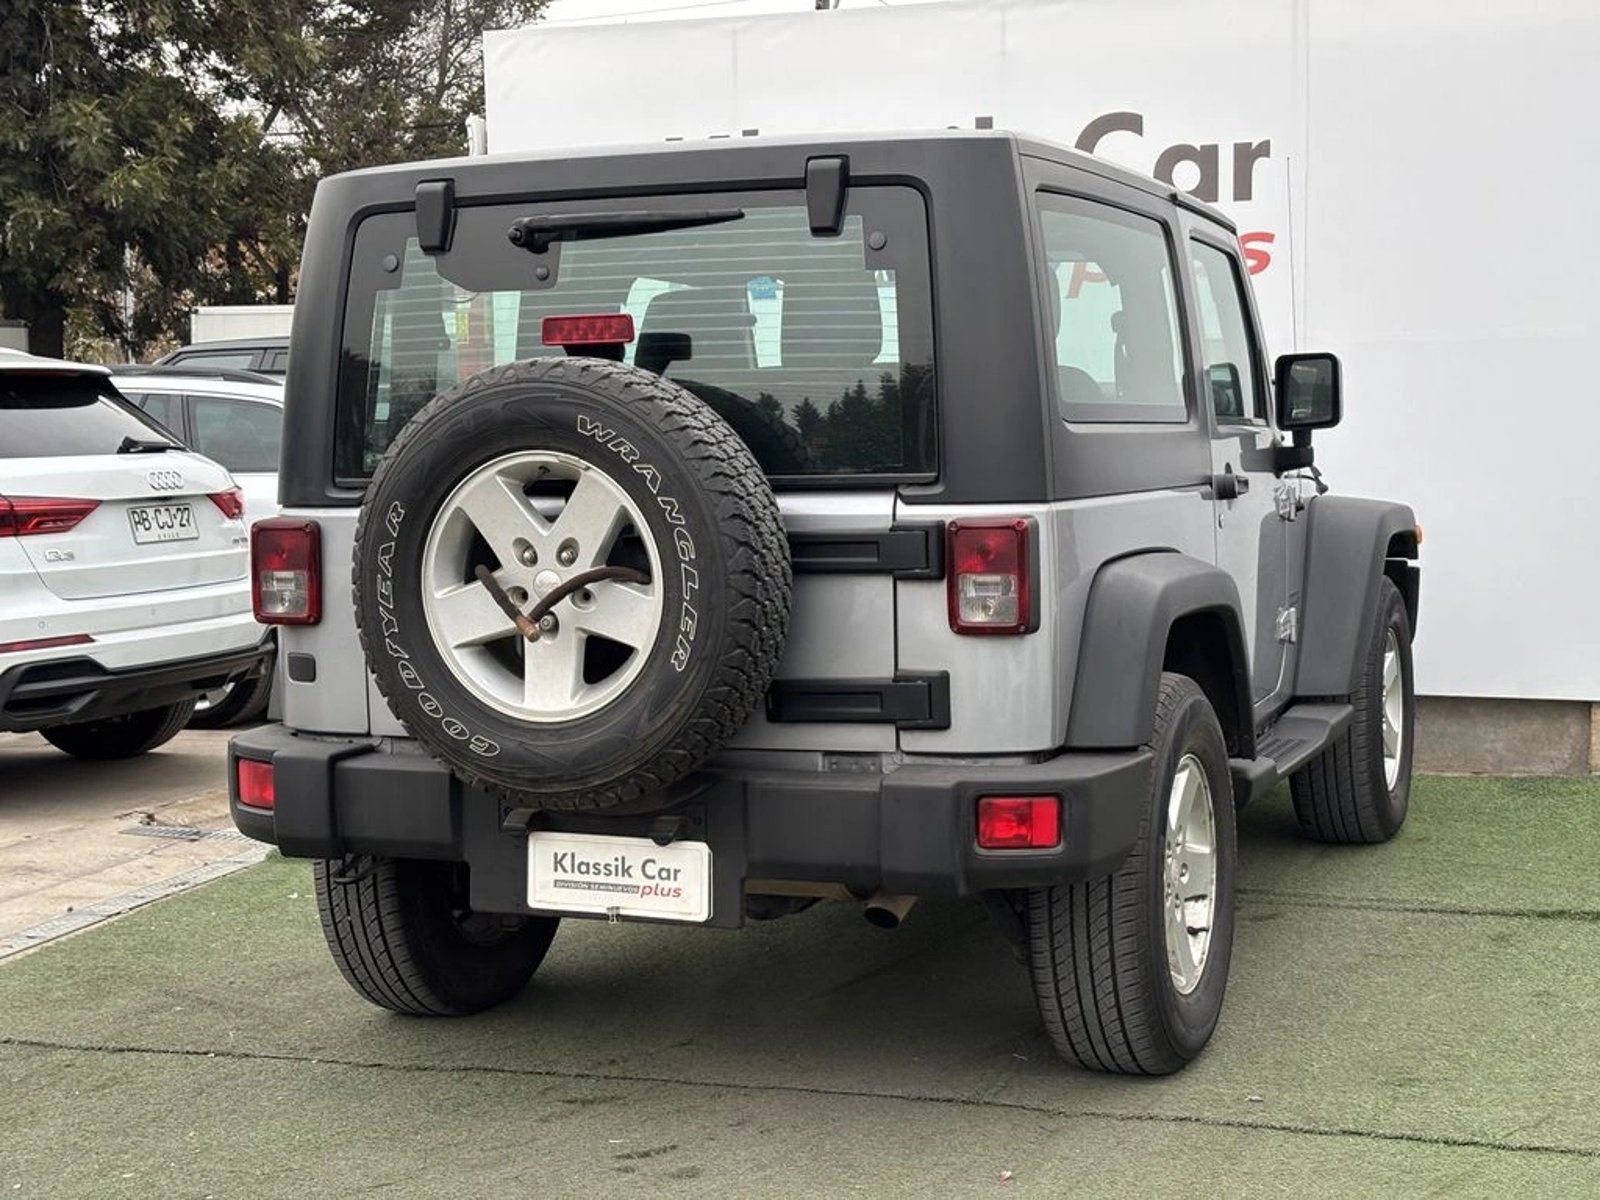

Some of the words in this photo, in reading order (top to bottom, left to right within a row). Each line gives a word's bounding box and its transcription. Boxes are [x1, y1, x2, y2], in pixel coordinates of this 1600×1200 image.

[578, 415, 698, 673] WRANGLER
[377, 501, 500, 757] GOODYEAR
[553, 852, 633, 878] Klassik
[641, 858, 681, 882] Car
[640, 883, 682, 898] plus
